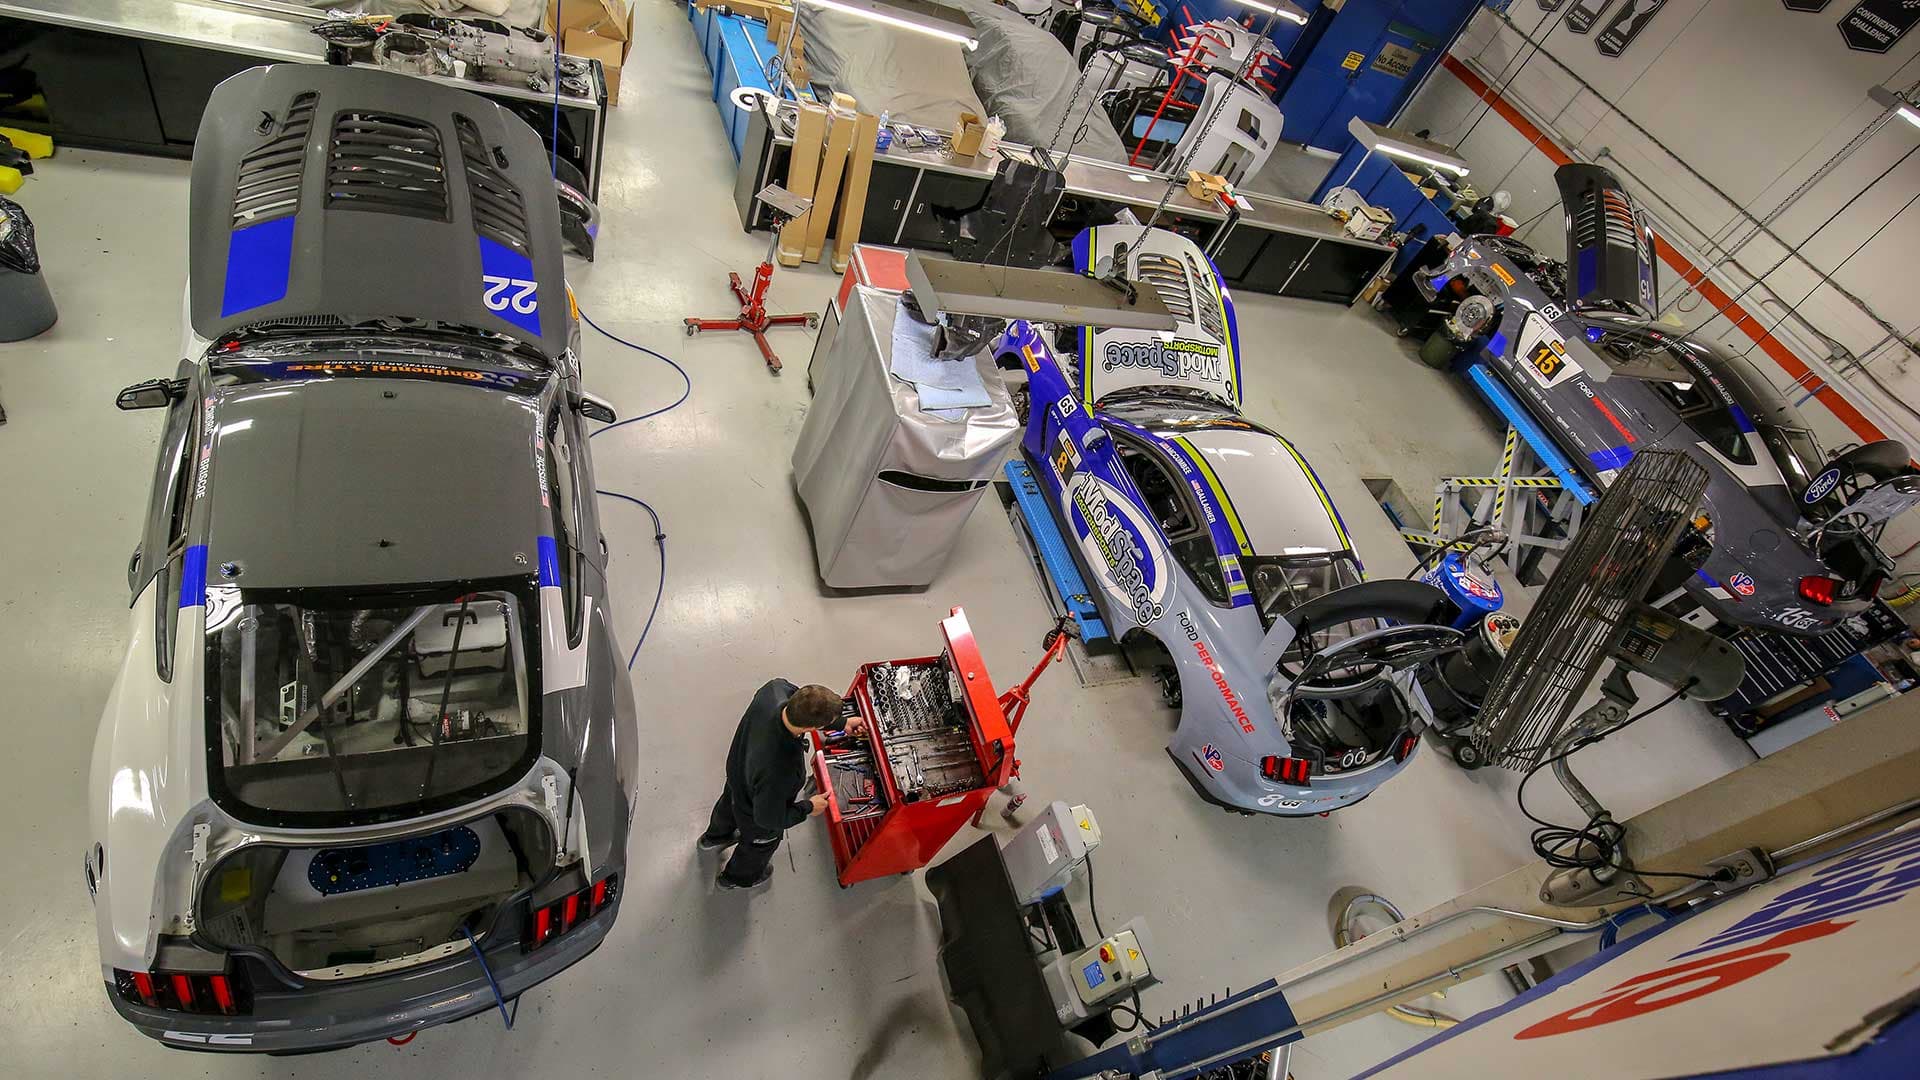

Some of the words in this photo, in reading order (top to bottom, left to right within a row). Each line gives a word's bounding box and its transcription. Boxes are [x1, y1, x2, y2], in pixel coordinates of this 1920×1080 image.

[1850, 17, 1891, 44] CHALLENGE
[1856, 7, 1901, 37] CONTINENTAL
[1376, 54, 1387, 64] No
[1386, 58, 1411, 73] Access
[483, 275, 538, 314] 22
[1641, 279, 1651, 300] 15
[1543, 306, 1560, 320] GS
[1163, 341, 1220, 357] MOTORSPORTS
[1105, 339, 1222, 383] ModSpace
[1533, 348, 1560, 375] 15
[1694, 359, 1713, 377] CUSTER
[371, 364, 485, 381] Continental
[1225, 380, 1234, 401] 8
[1577, 381, 1595, 399] FORD
[1060, 397, 1074, 415] GS
[1057, 451, 1068, 473] 8
[196, 458, 209, 500] BRISCOE
[1810, 475, 1835, 498] Ford
[1195, 488, 1217, 524] GALLAGHER
[1075, 494, 1118, 569] MOTORSPORTS
[1080, 472, 1155, 624] ModSpace
[1176, 611, 1199, 642] FORD
[1776, 607, 1813, 625] 15
[1257, 794, 1285, 807] 8
